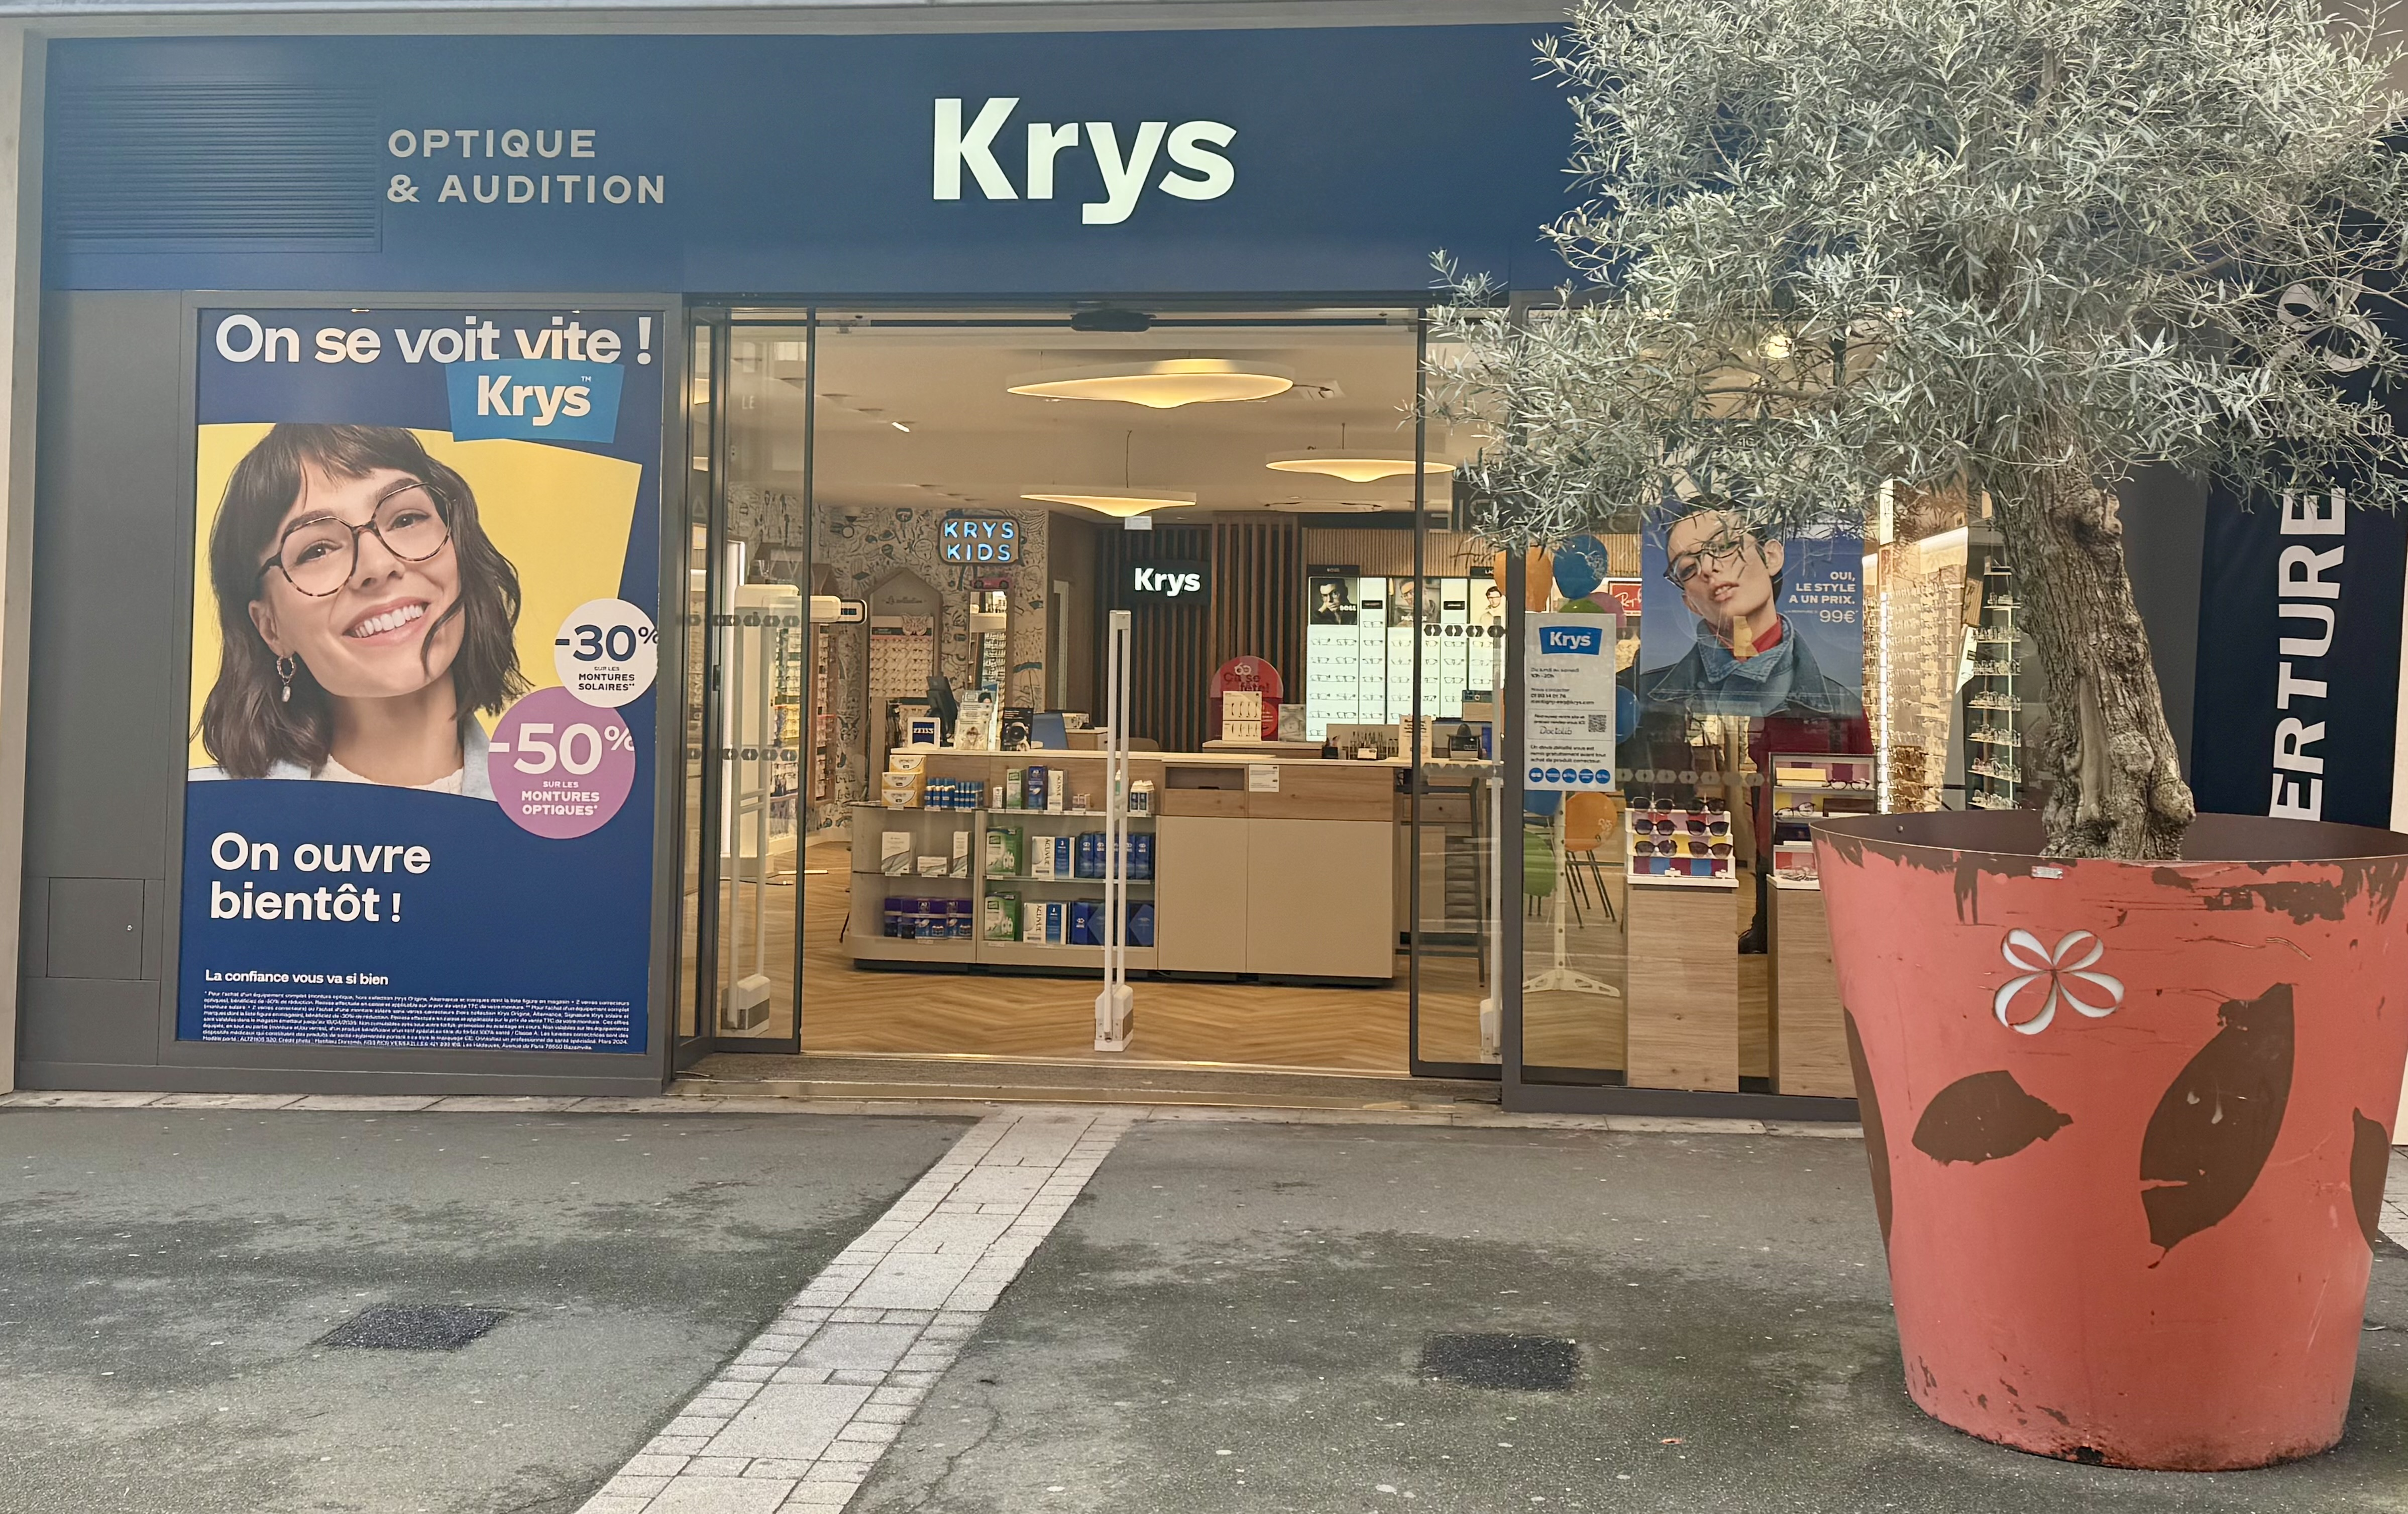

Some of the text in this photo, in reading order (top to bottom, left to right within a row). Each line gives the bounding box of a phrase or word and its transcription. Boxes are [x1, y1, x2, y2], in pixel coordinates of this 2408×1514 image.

[388, 129, 596, 158] OPTIQUE
[933, 97, 1237, 224] Krys
[387, 174, 664, 204] & AUDITION
[216, 314, 651, 366] On se voit vite !
[477, 375, 592, 426] Krys
[944, 521, 1015, 539] KRYS
[947, 543, 1011, 561] KIDS
[1135, 567, 1201, 597] Krys
[1796, 583, 1856, 592] LE STYLE
[1830, 571, 1855, 581] OUI,
[1789, 595, 1855, 604] A UN PRIX.
[555, 624, 659, 662] -30%
[1550, 631, 1592, 650] Krys
[579, 673, 635, 681] MONTURES
[488, 723, 635, 775] -50%
[521, 791, 600, 802] MONTURES
[211, 832, 431, 874] On ouvre
[210, 880, 401, 923] bientôt !
[205, 970, 389, 986] La confiance vous va si bien
